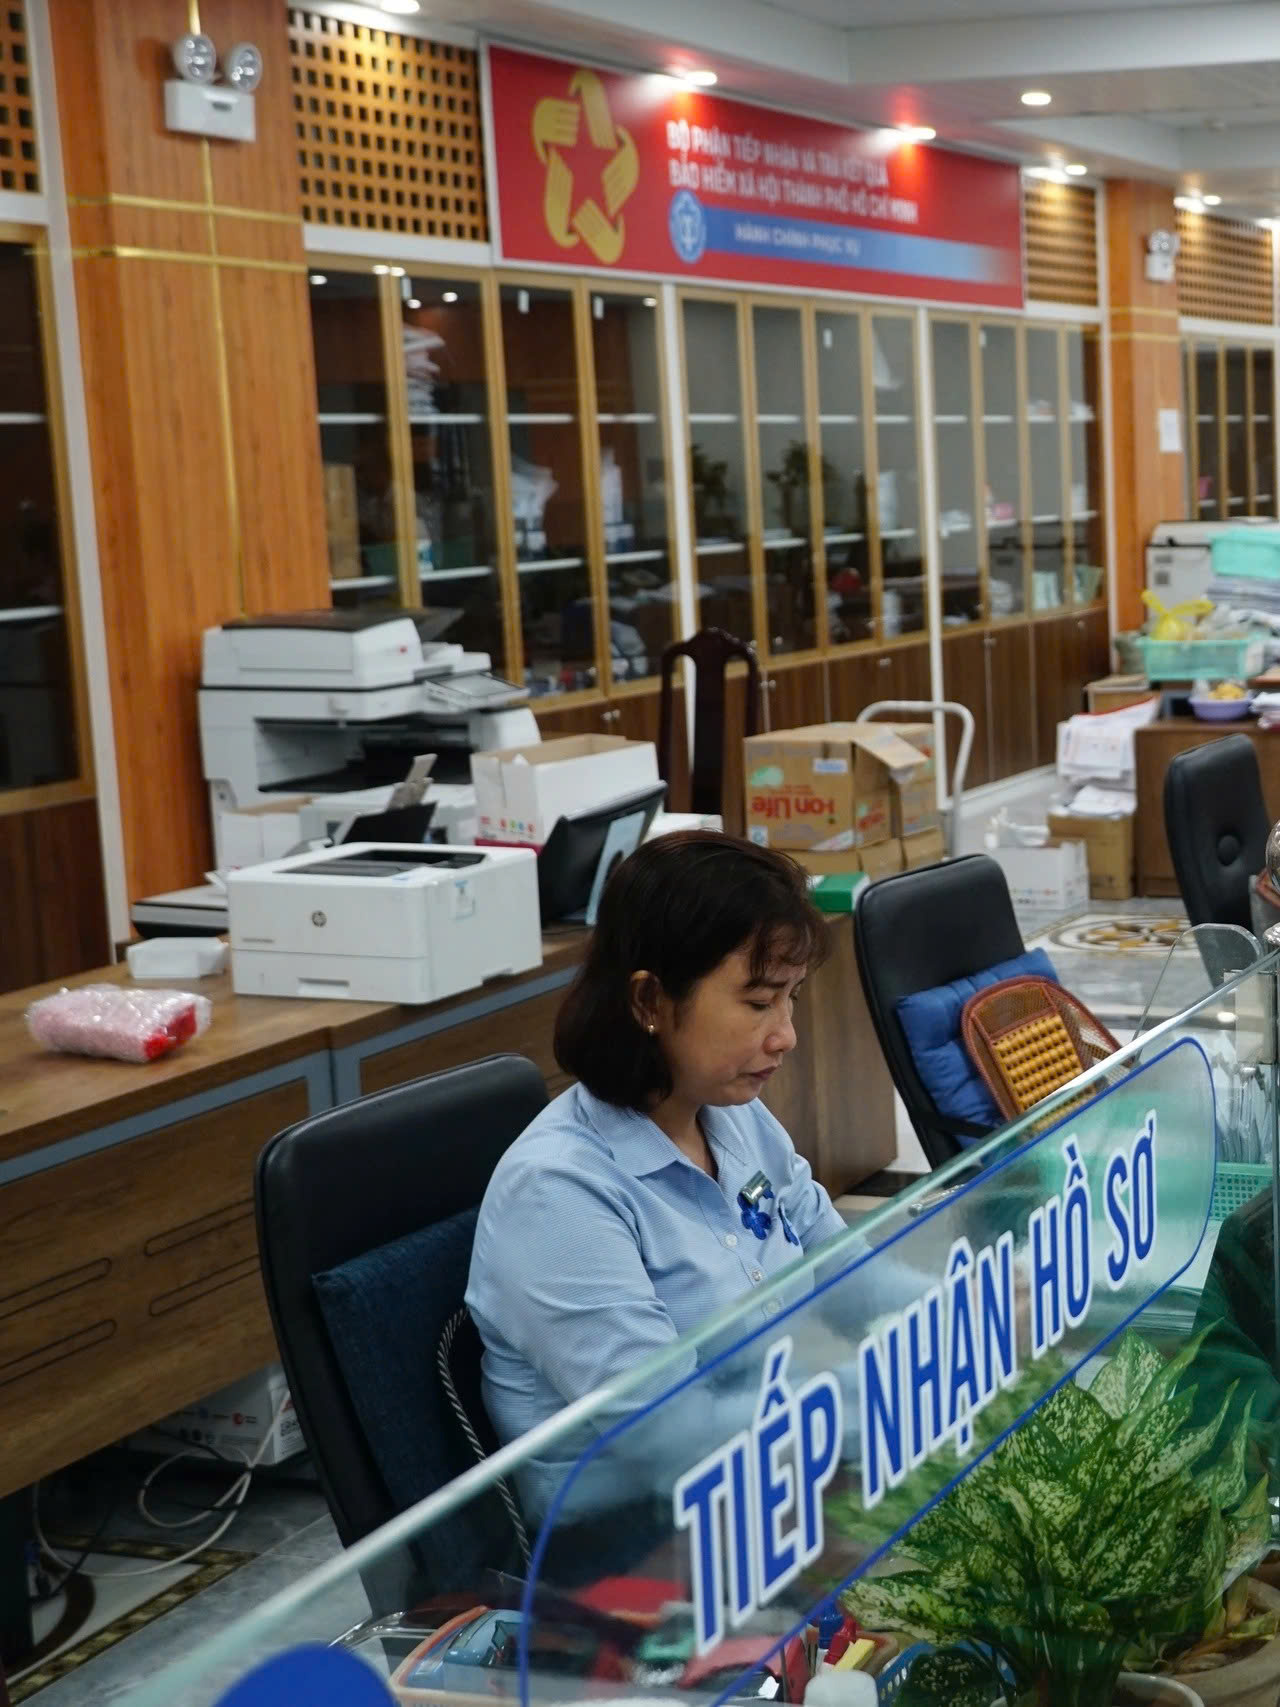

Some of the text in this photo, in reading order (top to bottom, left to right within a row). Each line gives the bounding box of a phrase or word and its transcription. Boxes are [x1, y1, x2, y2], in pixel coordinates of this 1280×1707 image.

[668, 154, 699, 190] BẢO
[674, 1109, 1157, 1656] TIẾP NHẬN HỒ SƠ
